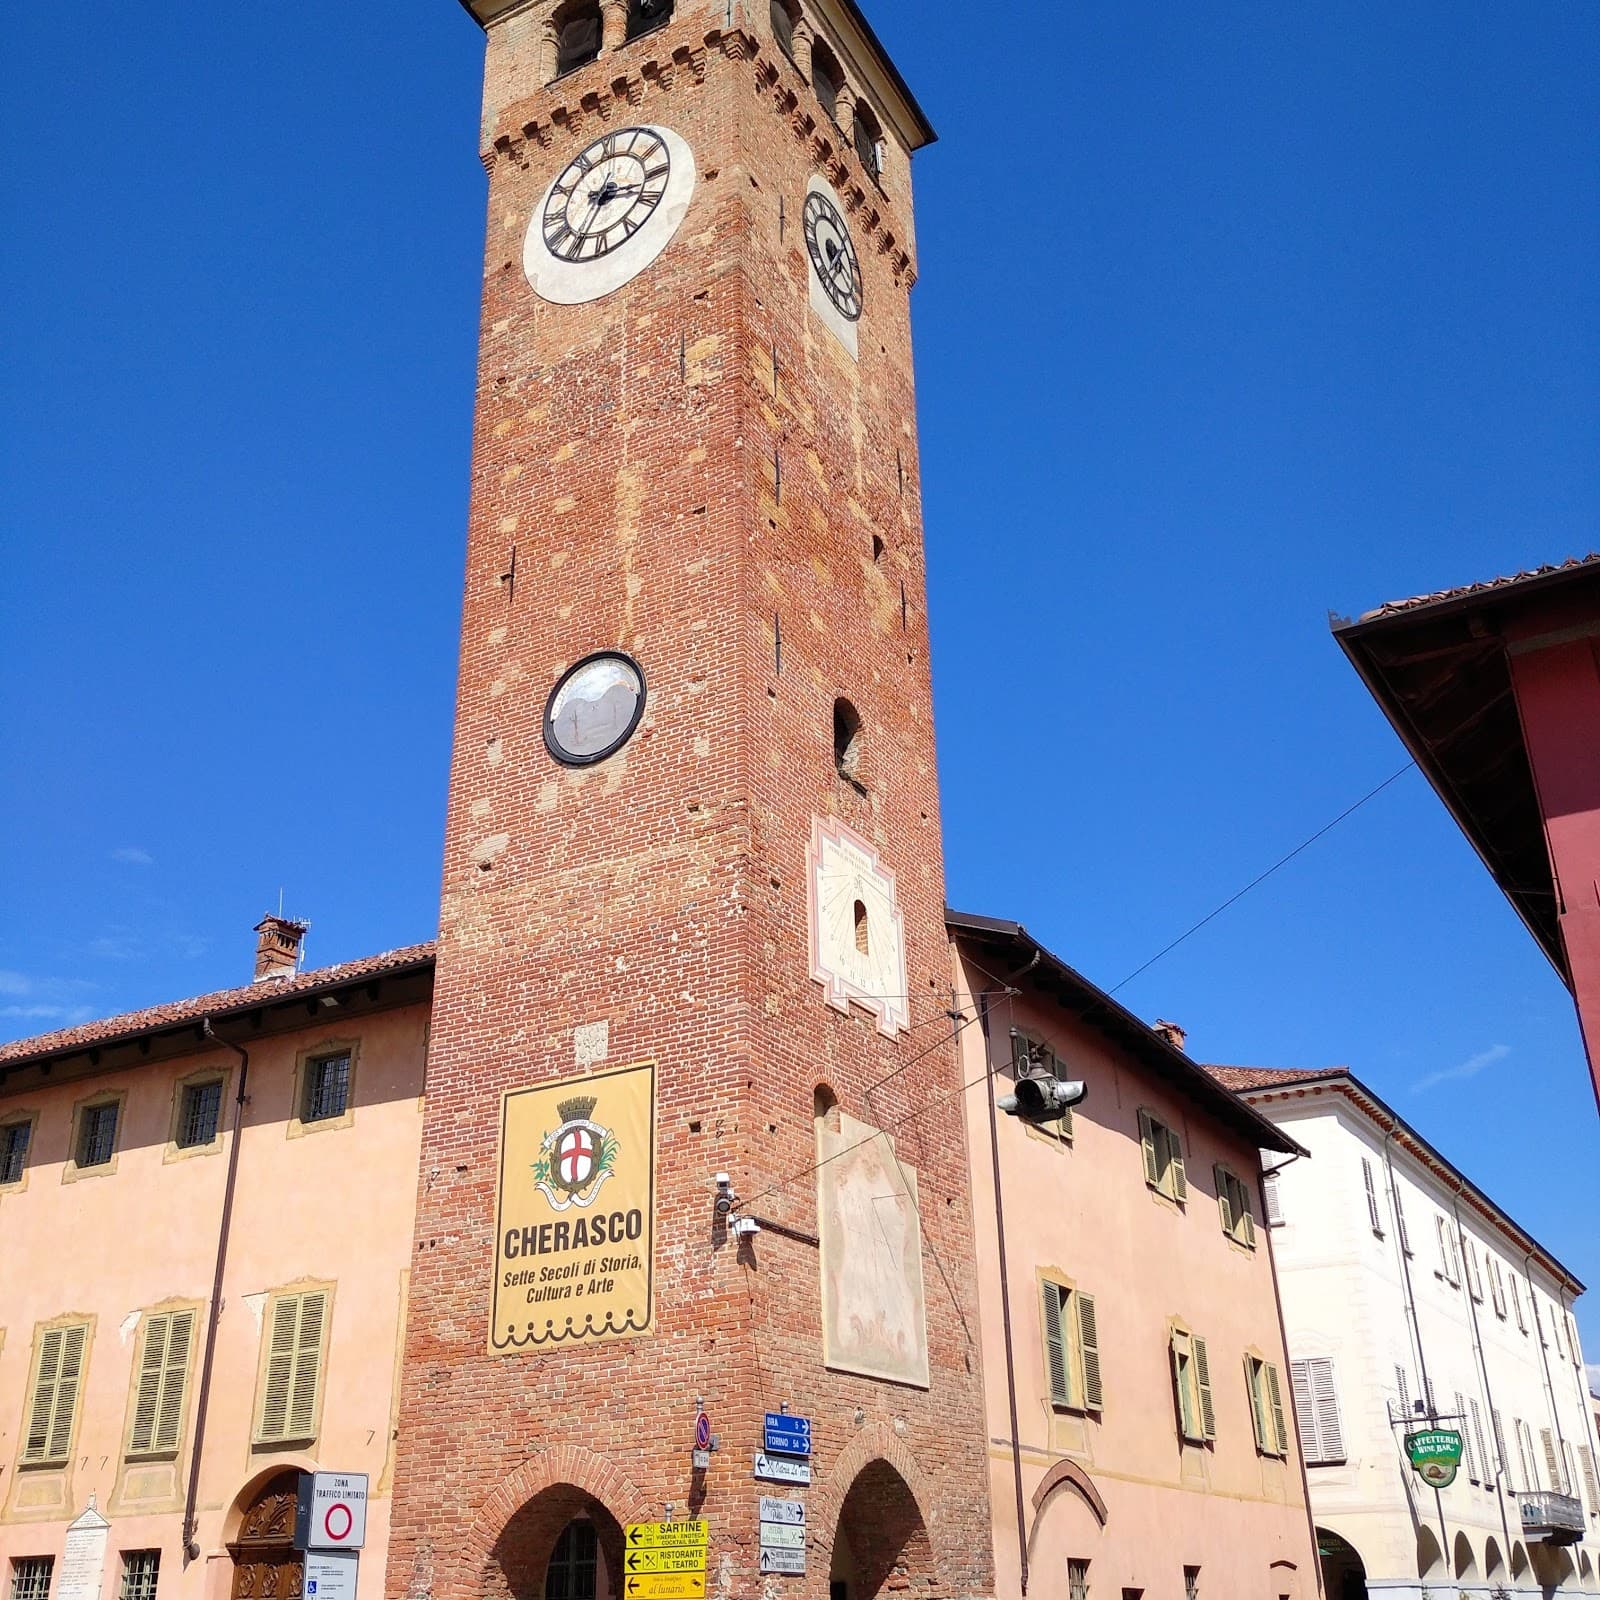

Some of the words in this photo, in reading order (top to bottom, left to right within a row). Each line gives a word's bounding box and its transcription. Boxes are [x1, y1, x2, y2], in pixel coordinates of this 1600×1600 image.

[504, 1209, 642, 1259] CHERASCO
[503, 1270, 536, 1287] Sette
[539, 1262, 580, 1282] Secoli
[583, 1259, 597, 1276] di
[600, 1254, 642, 1273] Storia,
[526, 1285, 571, 1303] Cultura
[575, 1283, 583, 1296] e
[587, 1277, 614, 1295] Arte
[768, 1435, 789, 1447] TORINO
[1408, 1435, 1459, 1451] CAFFETTERIA
[334, 1479, 349, 1488] ZONA
[316, 1489, 341, 1498] TRAFFICO
[342, 1490, 365, 1500] LIMITATO
[659, 1522, 702, 1533] SARTINE
[660, 1550, 703, 1559] RISTORANTE
[664, 1561, 670, 1569] IL
[672, 1560, 699, 1569] TEATRO
[658, 1583, 685, 1593] lunario
